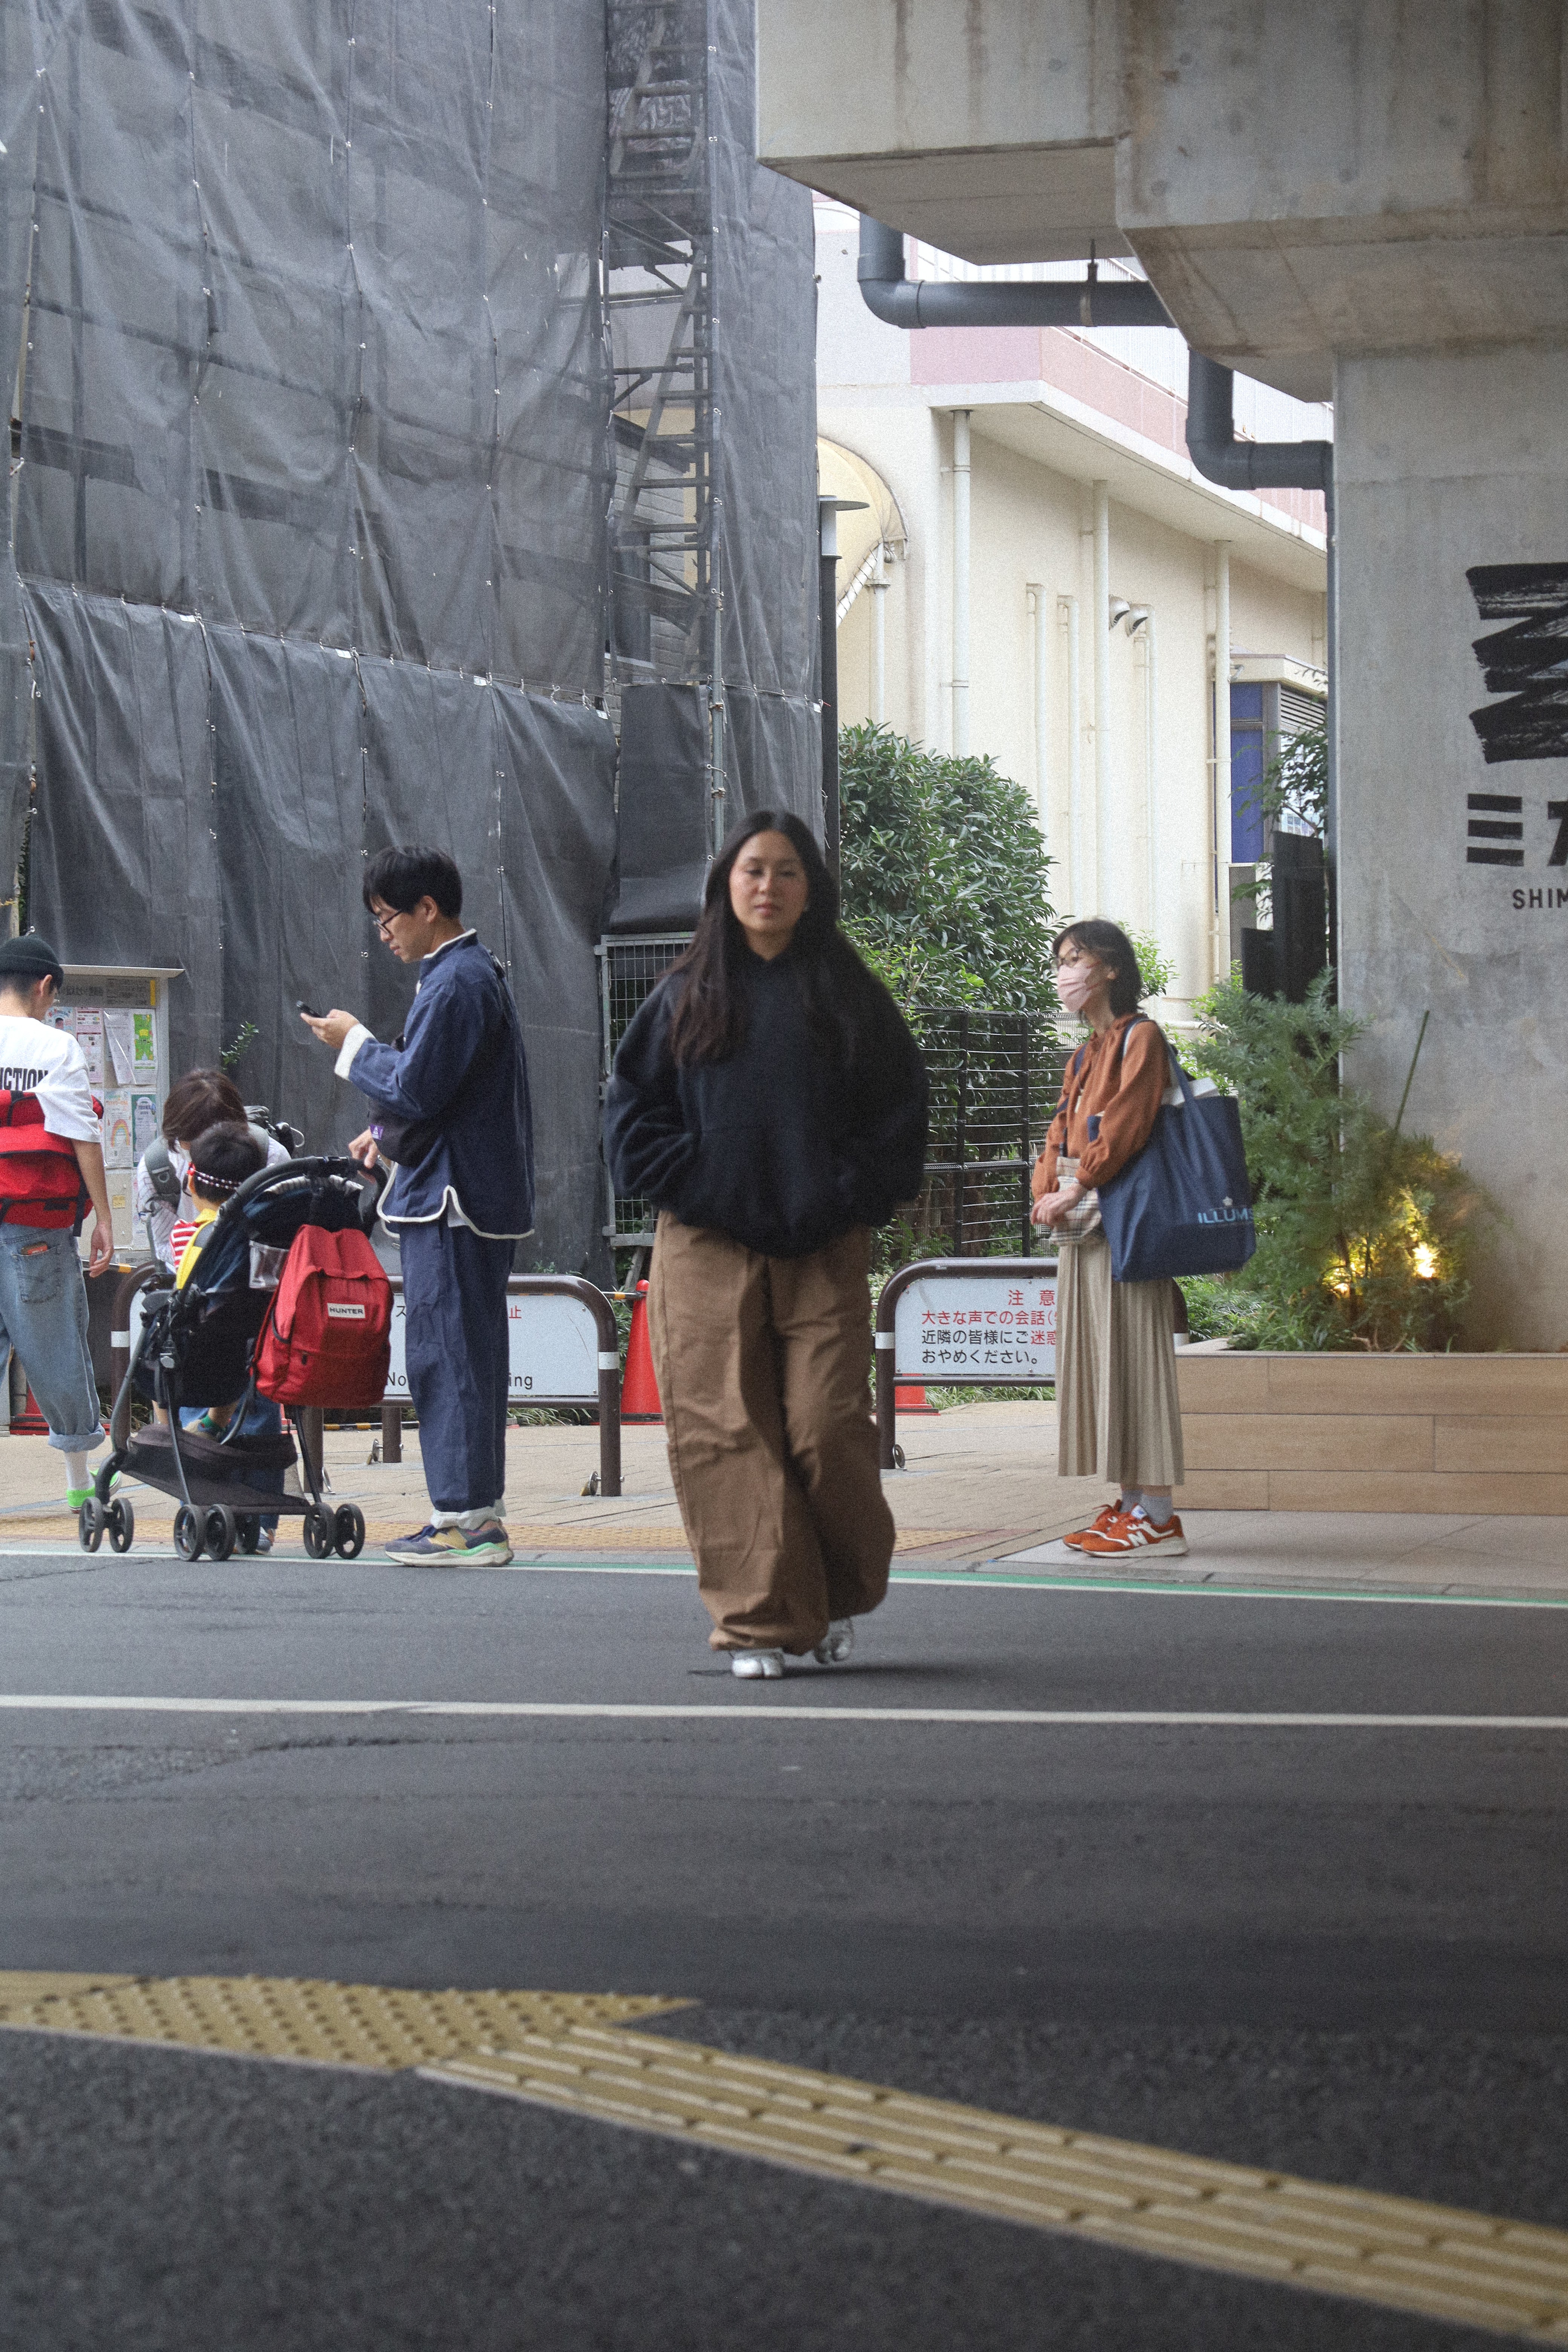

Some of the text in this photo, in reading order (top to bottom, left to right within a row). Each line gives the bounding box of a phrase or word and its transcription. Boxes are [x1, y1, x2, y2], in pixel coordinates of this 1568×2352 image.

[922, 1349, 1038, 1364] おやめください。
